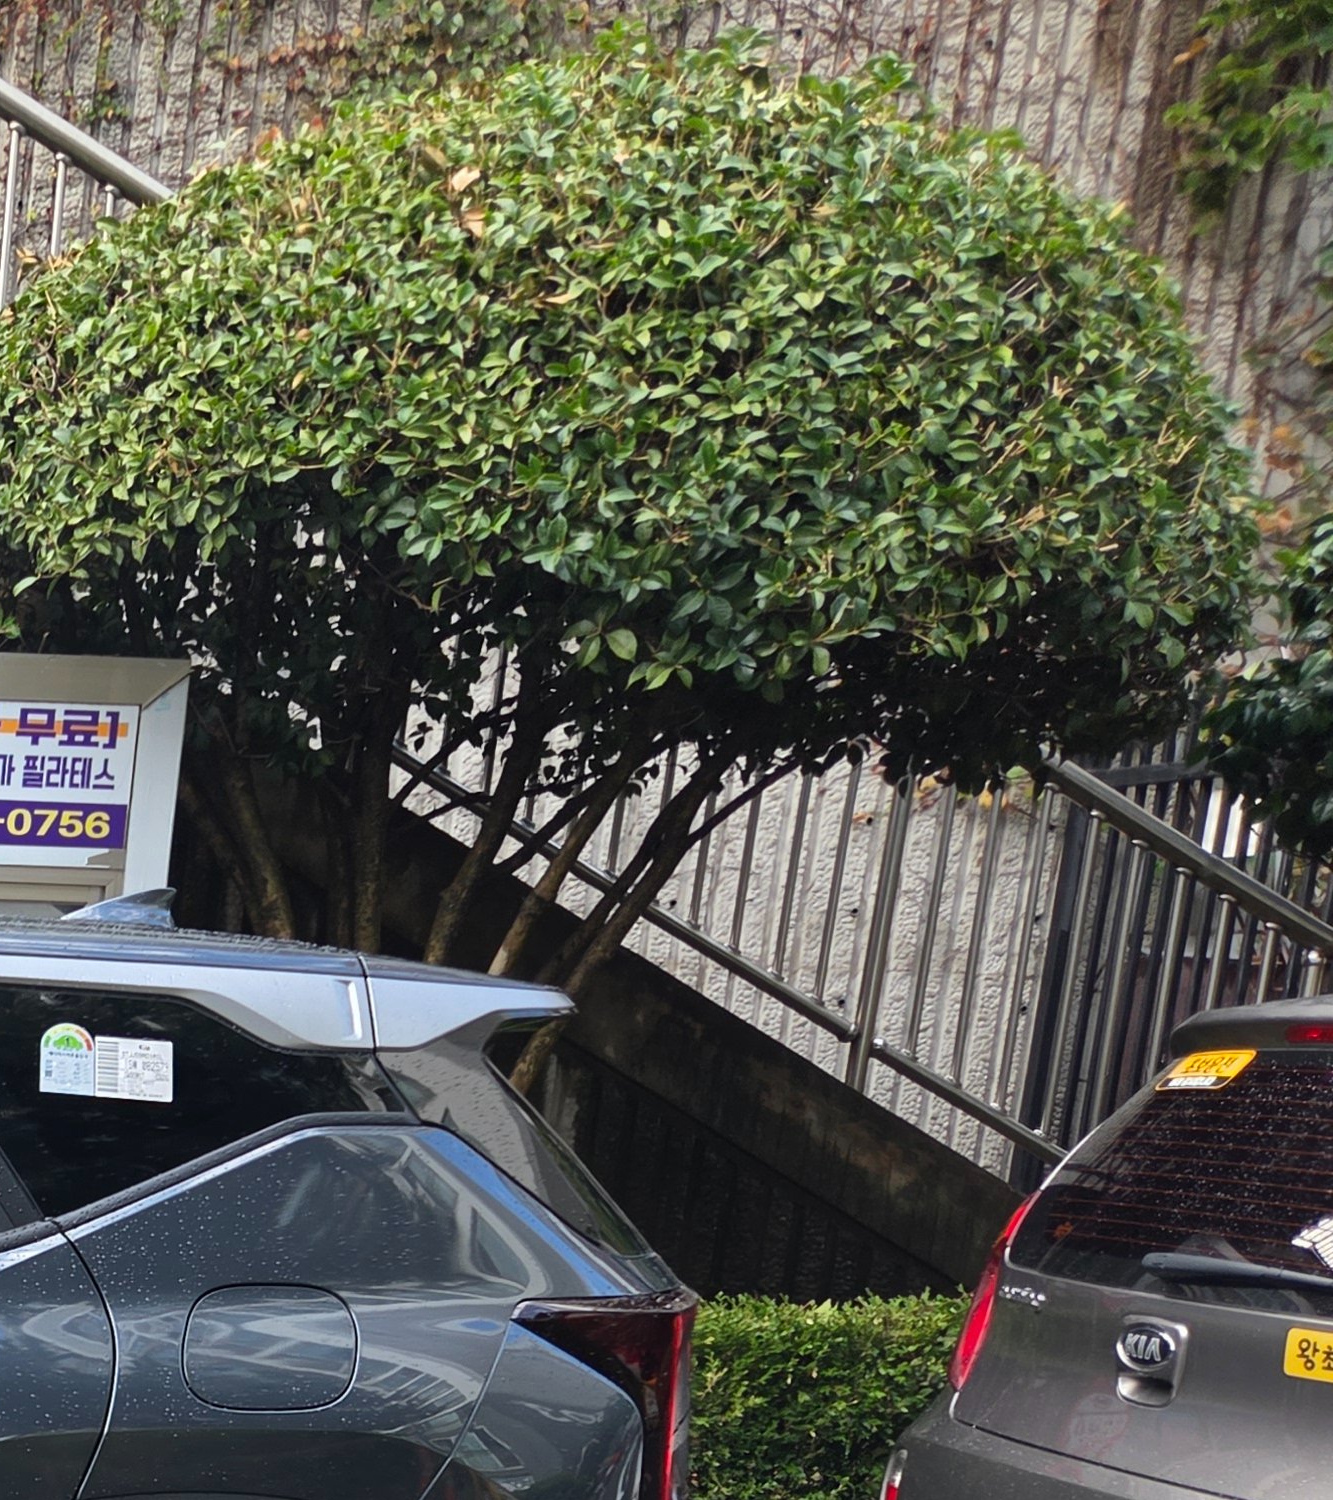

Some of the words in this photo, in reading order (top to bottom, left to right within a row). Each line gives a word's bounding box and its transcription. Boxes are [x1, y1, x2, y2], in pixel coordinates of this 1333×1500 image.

[16, 708, 120, 749] 무료]
[22, 756, 115, 790] 필라테스
[1124, 1332, 1161, 1362] KIA
